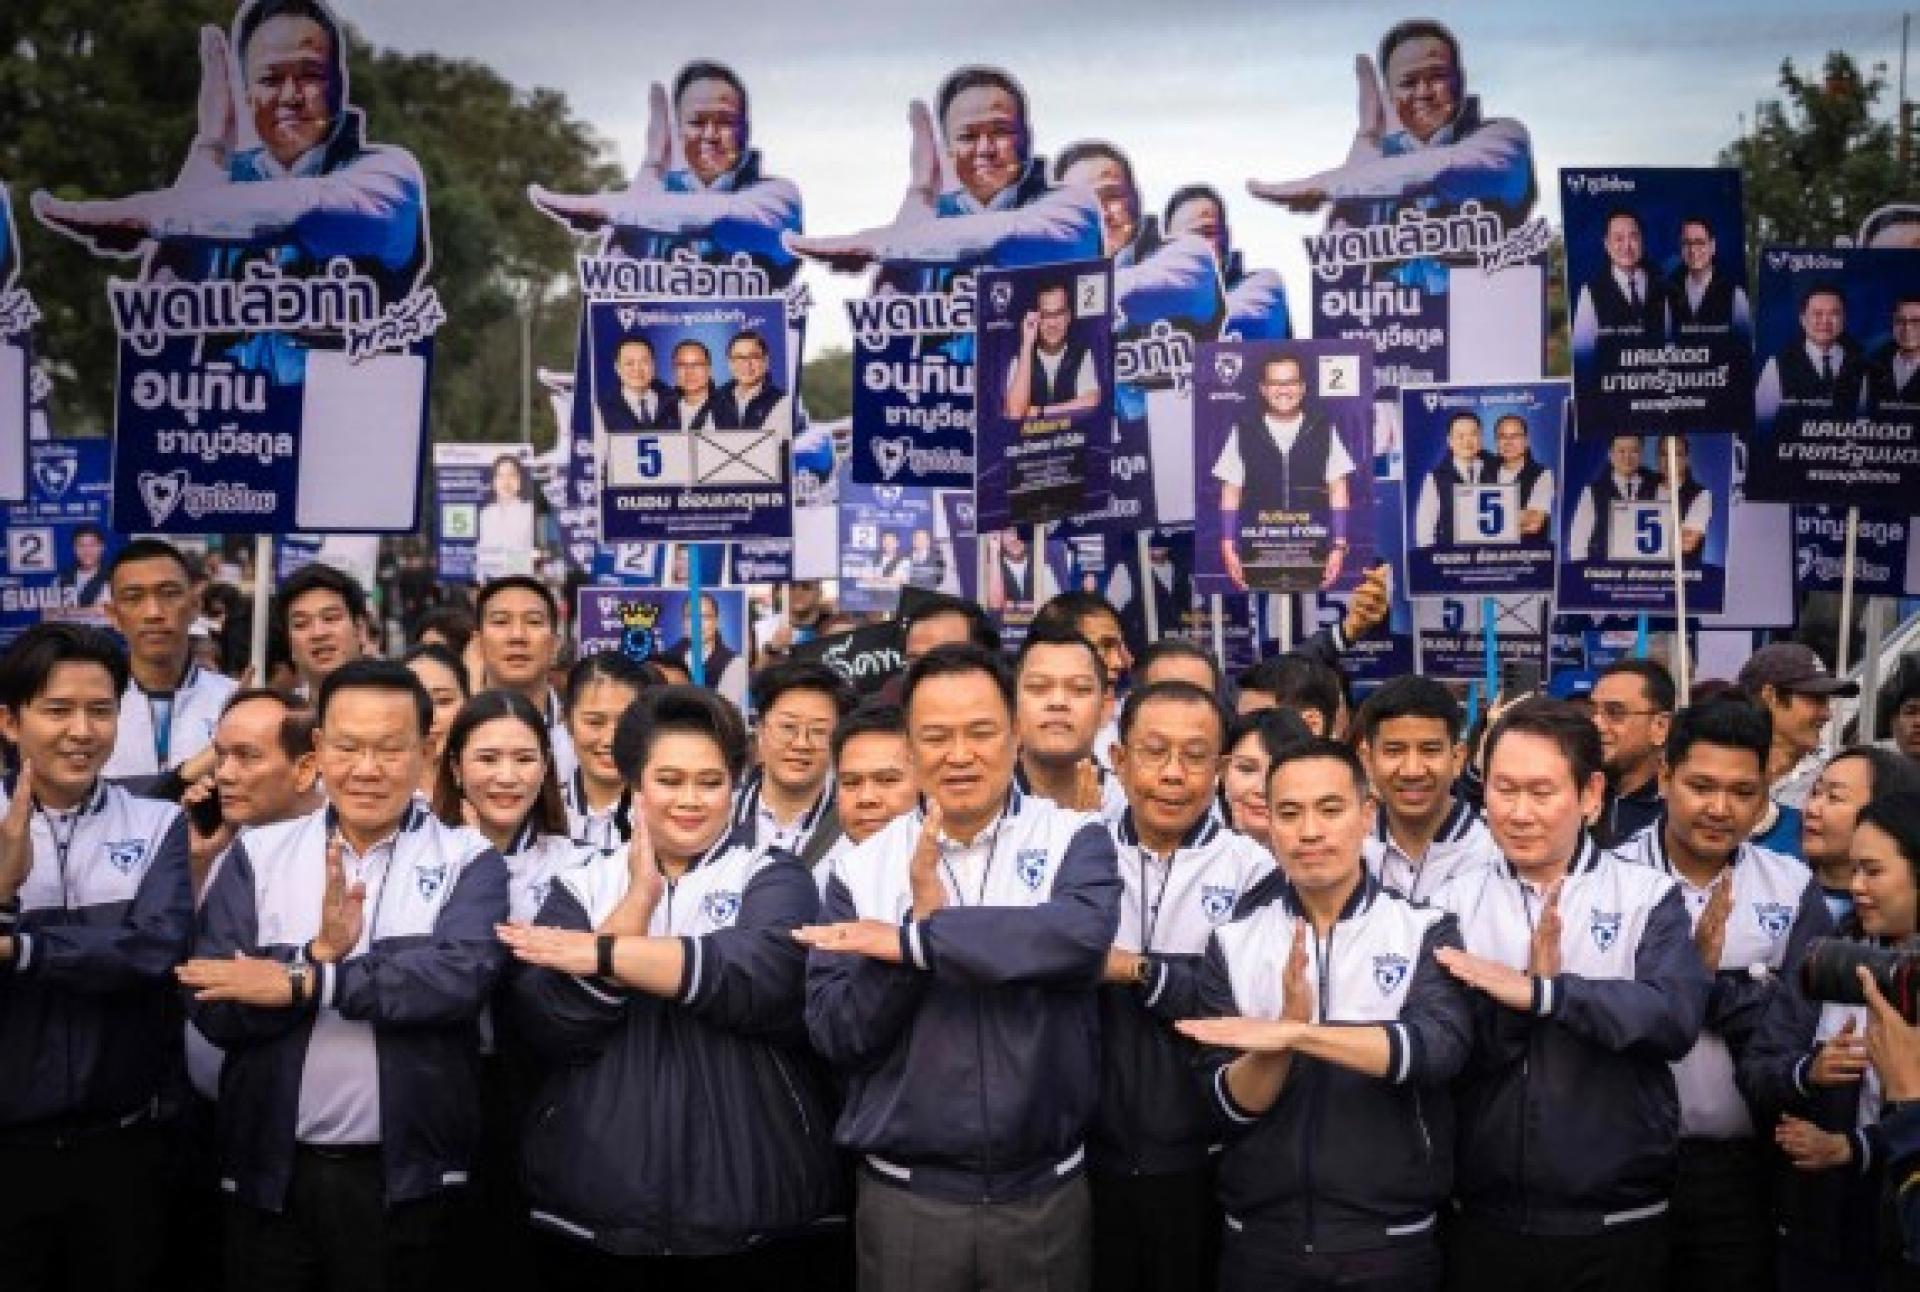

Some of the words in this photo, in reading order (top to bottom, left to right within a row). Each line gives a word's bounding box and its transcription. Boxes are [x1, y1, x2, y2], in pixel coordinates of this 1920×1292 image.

[1305, 202, 1502, 281] พูดแล้วทำ
[580, 253, 770, 297] พดแล้วทำ
[112, 258, 377, 353] พูดแล้วทำ
[1321, 282, 1422, 326] อนุทิน
[131, 361, 267, 426] อนุทิน
[865, 355, 975, 403] อนุทิน
[1327, 368, 1346, 390] 2
[157, 423, 293, 464] ชาญวีรกูล
[636, 436, 662, 478] 5
[1477, 490, 1505, 538] 5
[1635, 509, 1662, 554] 5
[20, 535, 43, 565] 2
